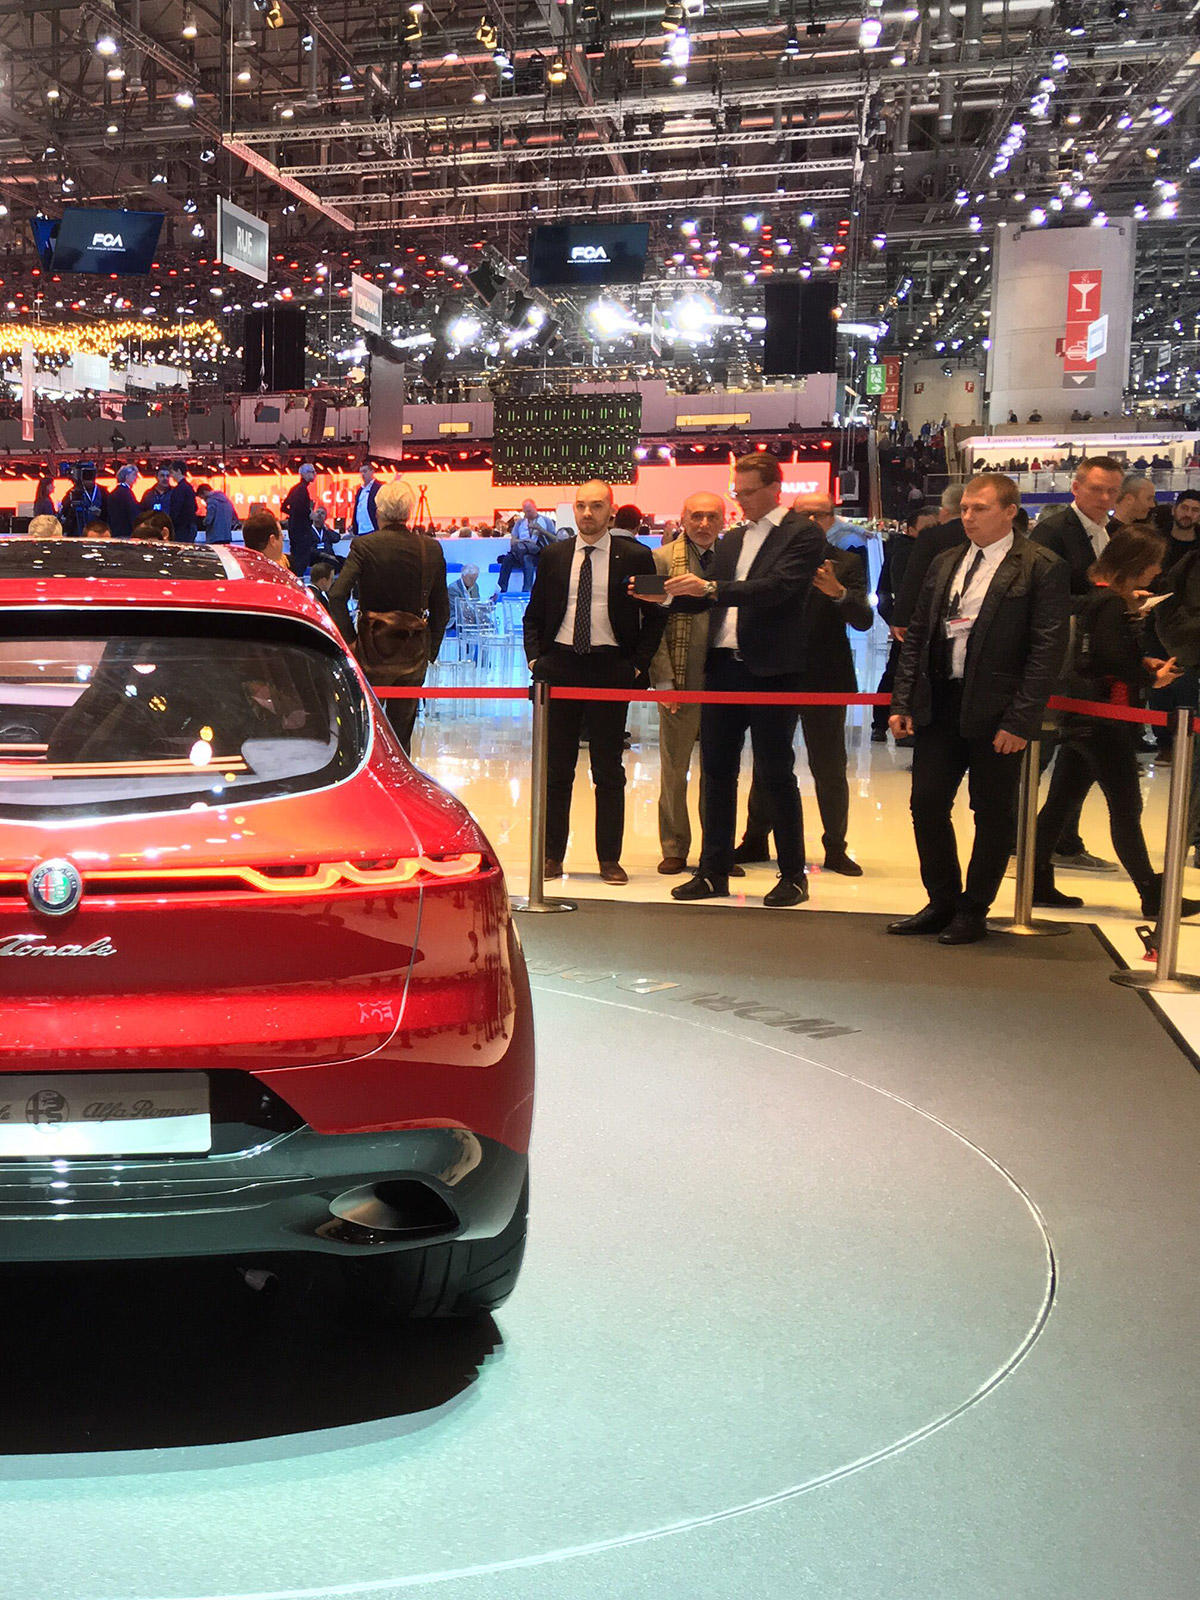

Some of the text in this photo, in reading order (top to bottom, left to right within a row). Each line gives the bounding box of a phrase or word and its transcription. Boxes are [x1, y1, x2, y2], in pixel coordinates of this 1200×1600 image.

[92, 233, 123, 247] FCA
[571, 246, 607, 260] FCA
[82, 1099, 198, 1123] Alfa Romeo
